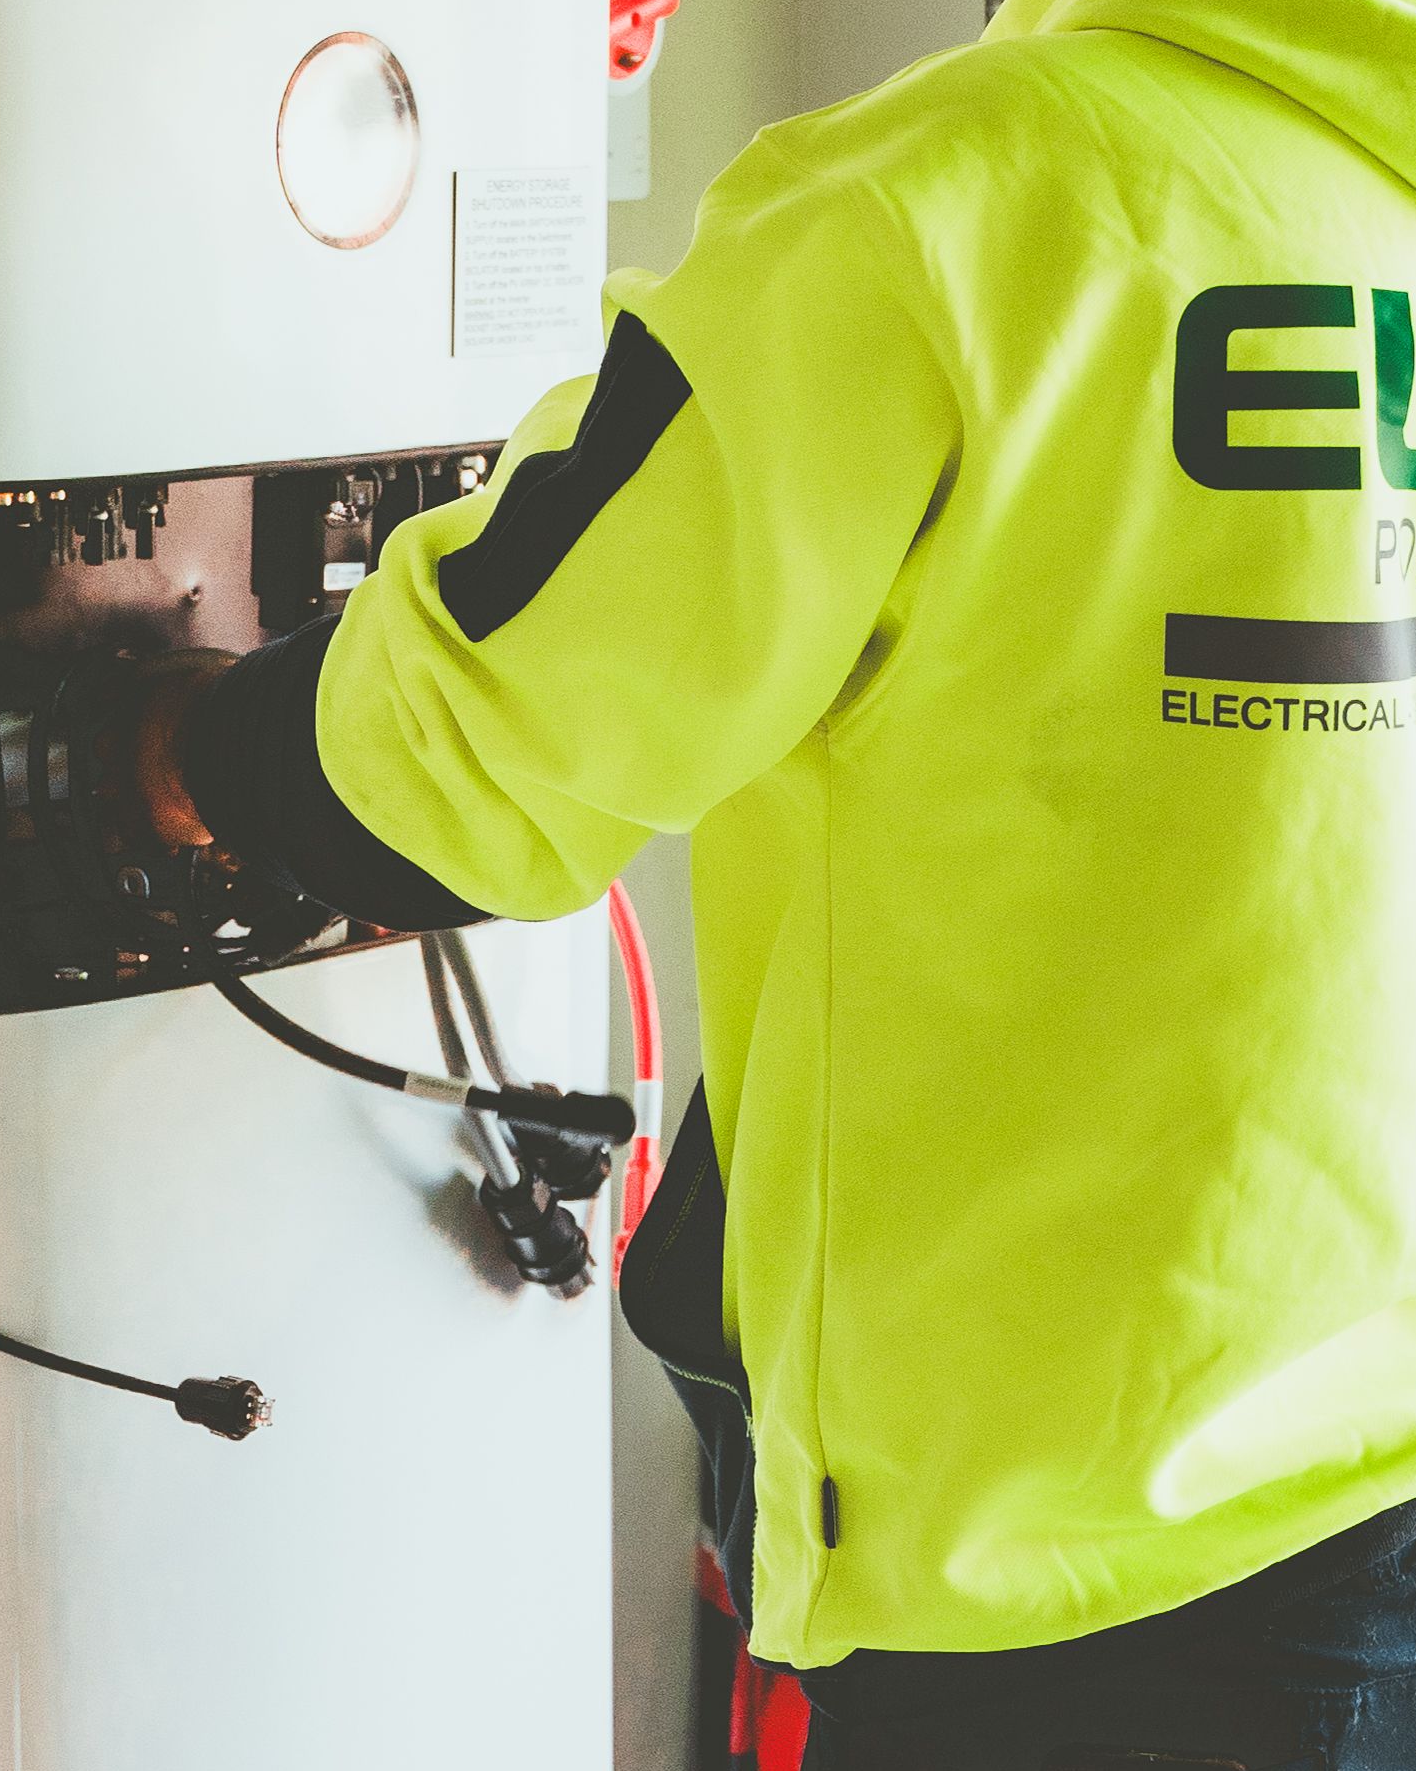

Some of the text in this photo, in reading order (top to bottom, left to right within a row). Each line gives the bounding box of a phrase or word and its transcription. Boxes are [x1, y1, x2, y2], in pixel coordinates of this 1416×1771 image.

[486, 177, 571, 193] ENERGY STORAGE
[471, 194, 584, 211] SHUTDOWN PROCEDURE
[1160, 689, 1405, 733] ELECTRICAL
